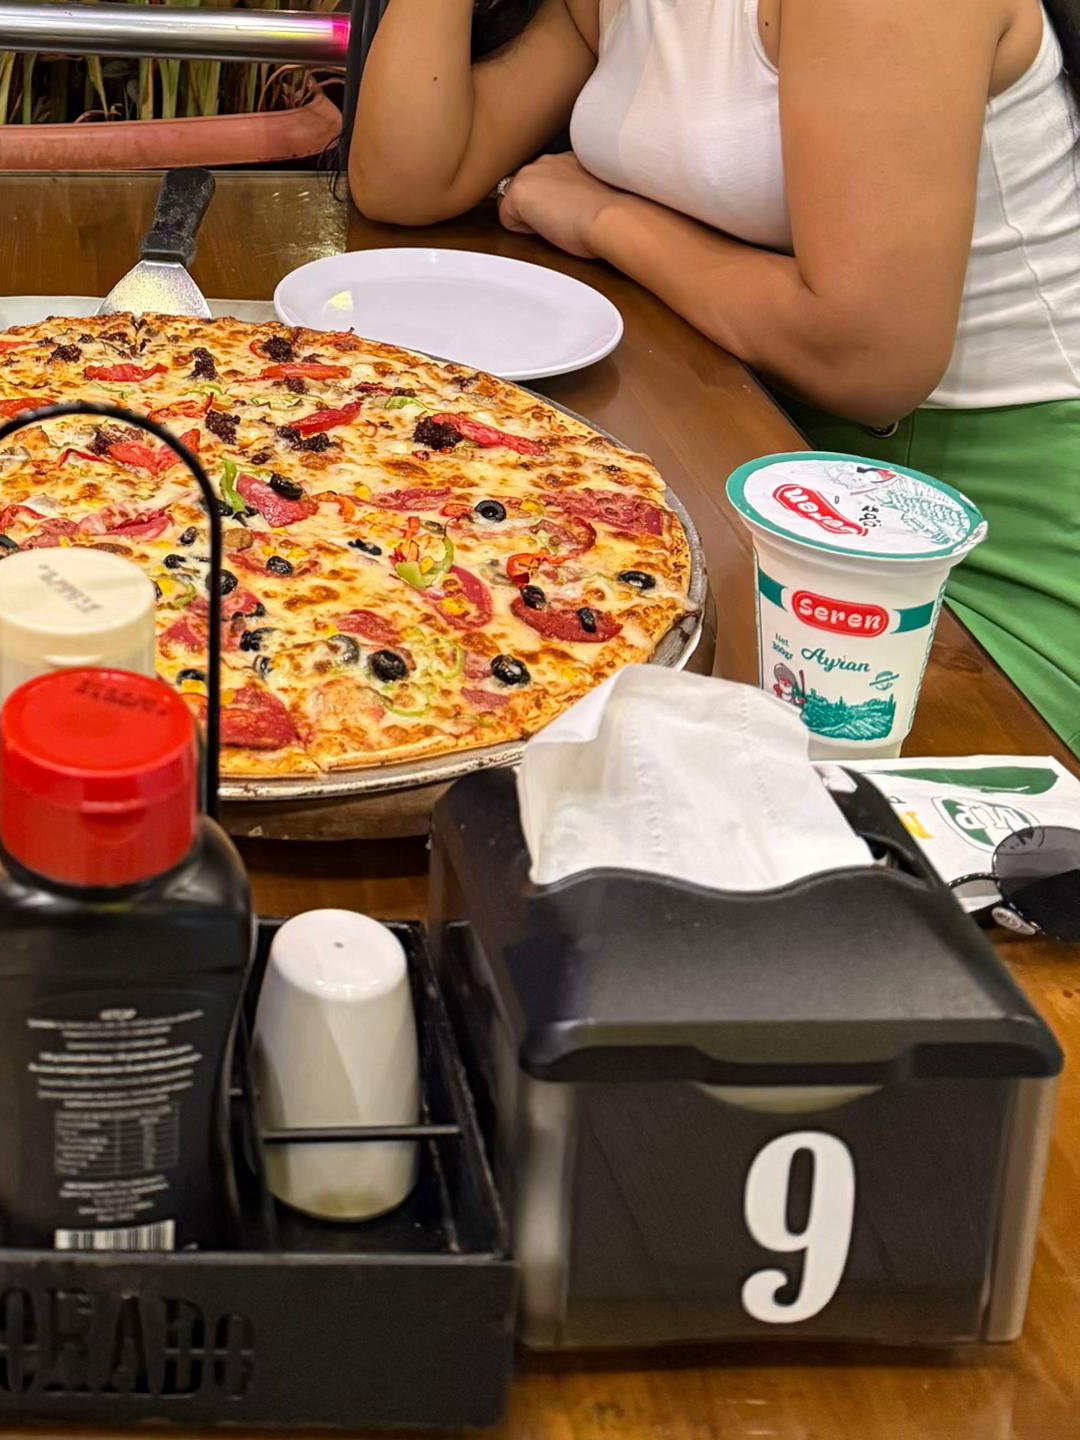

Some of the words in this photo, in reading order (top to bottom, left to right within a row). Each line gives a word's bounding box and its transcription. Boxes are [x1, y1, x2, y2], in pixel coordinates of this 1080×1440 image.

[797, 595, 883, 630] Seren
[801, 647, 871, 672] Ayran
[740, 1129, 858, 1326] 9
